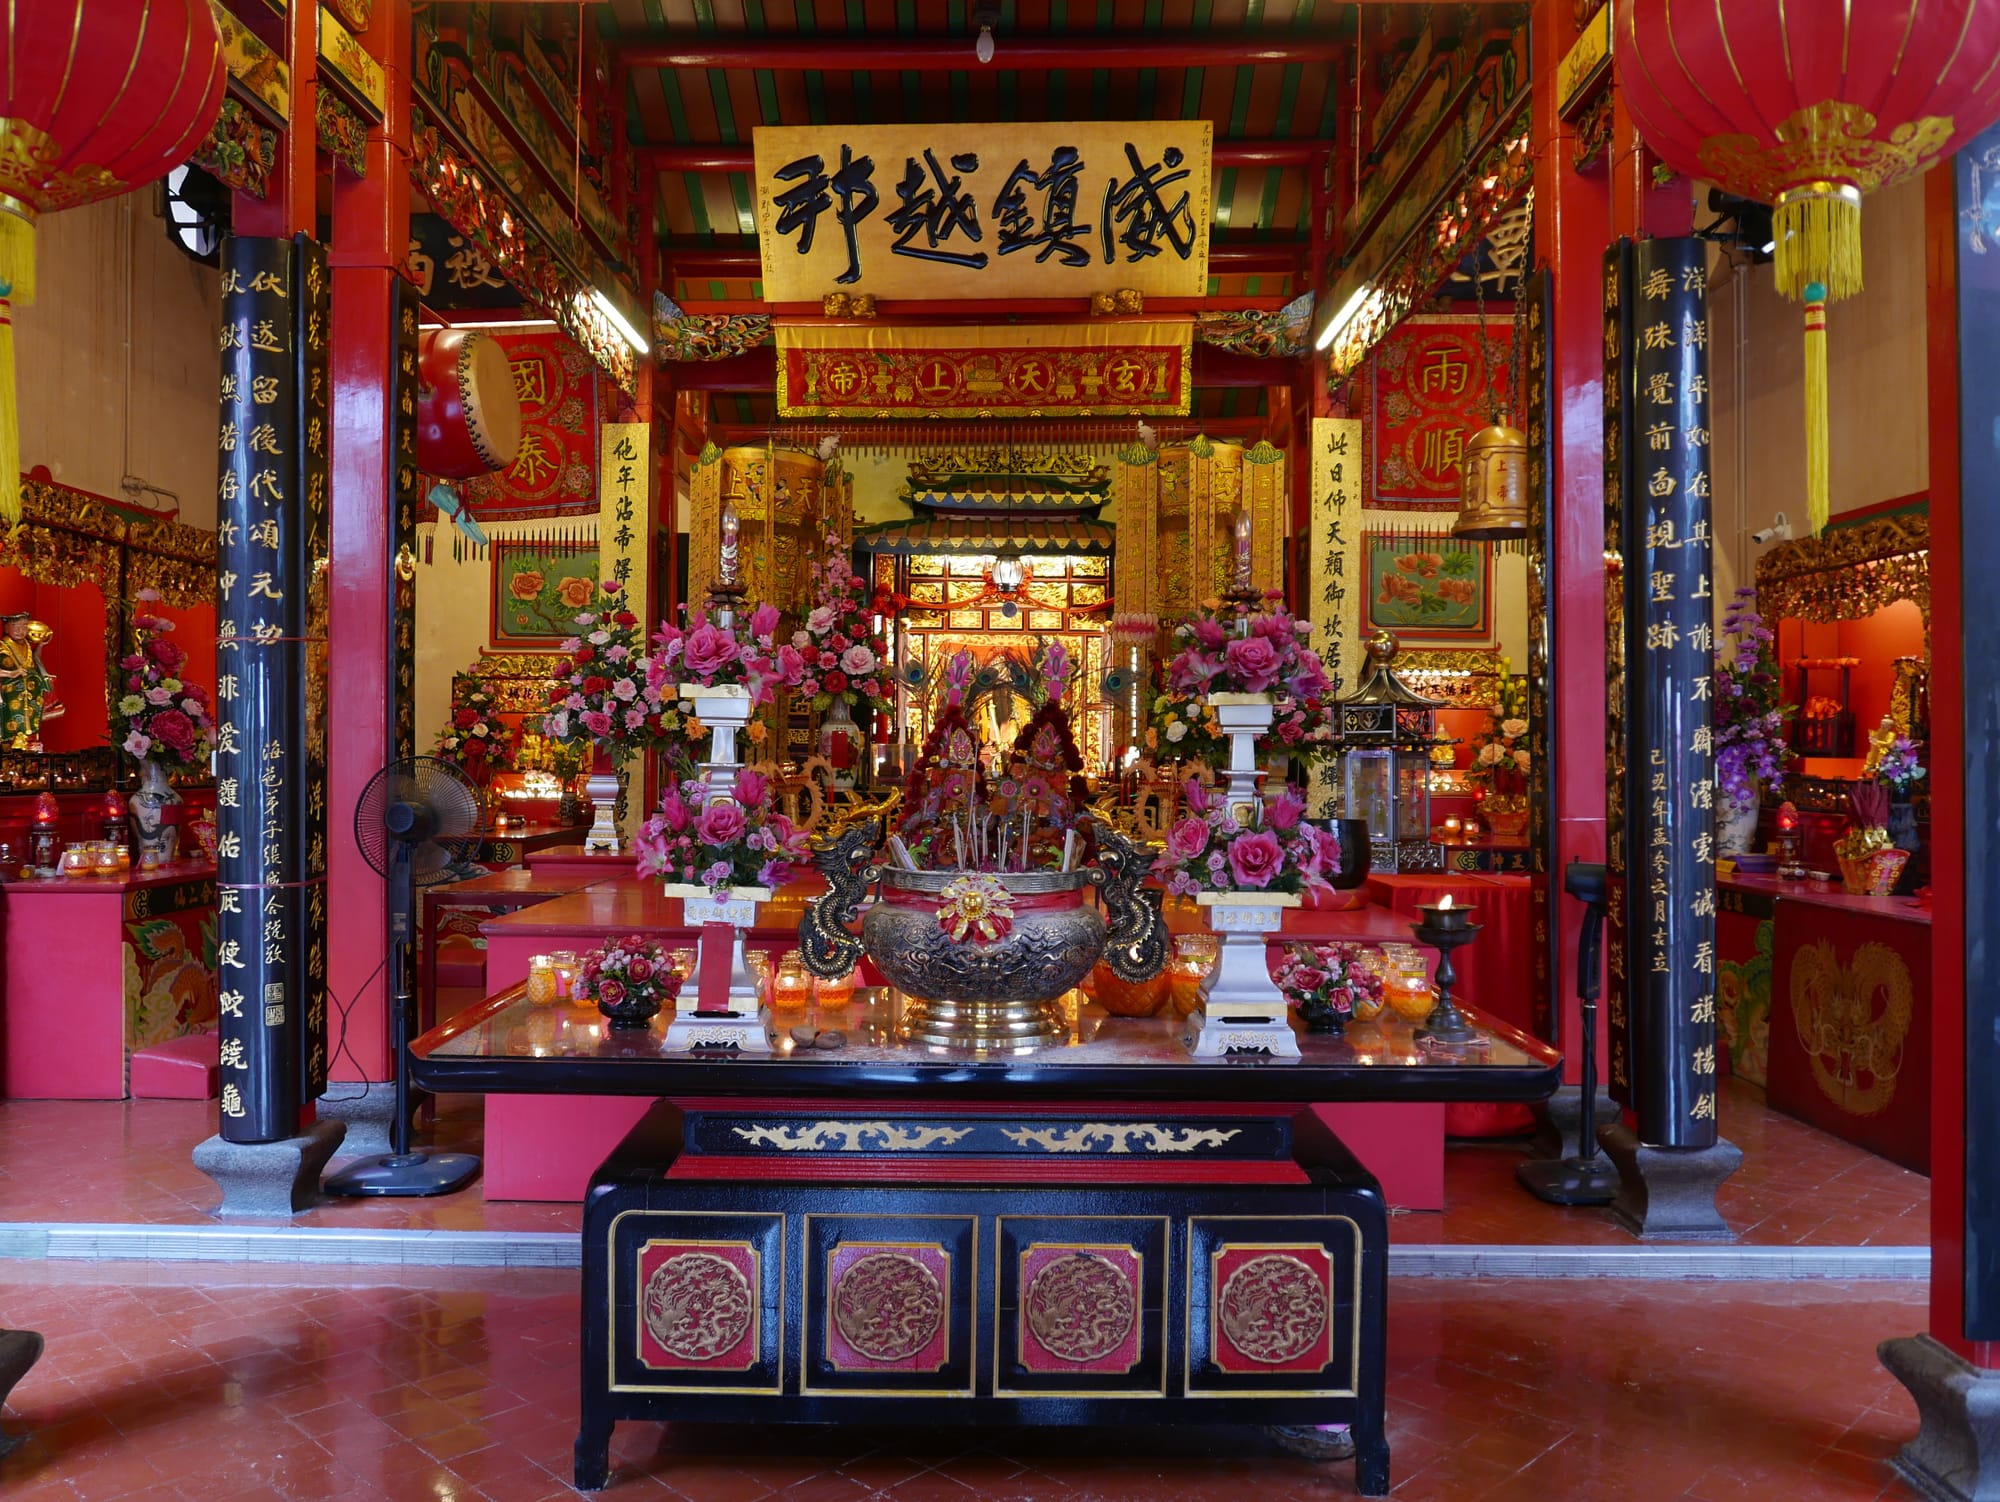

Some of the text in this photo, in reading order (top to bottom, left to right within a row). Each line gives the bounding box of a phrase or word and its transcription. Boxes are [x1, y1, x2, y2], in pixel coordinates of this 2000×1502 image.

[829, 360, 1147, 394] 玄天上帝
[1421, 348, 1468, 477] 雨順
